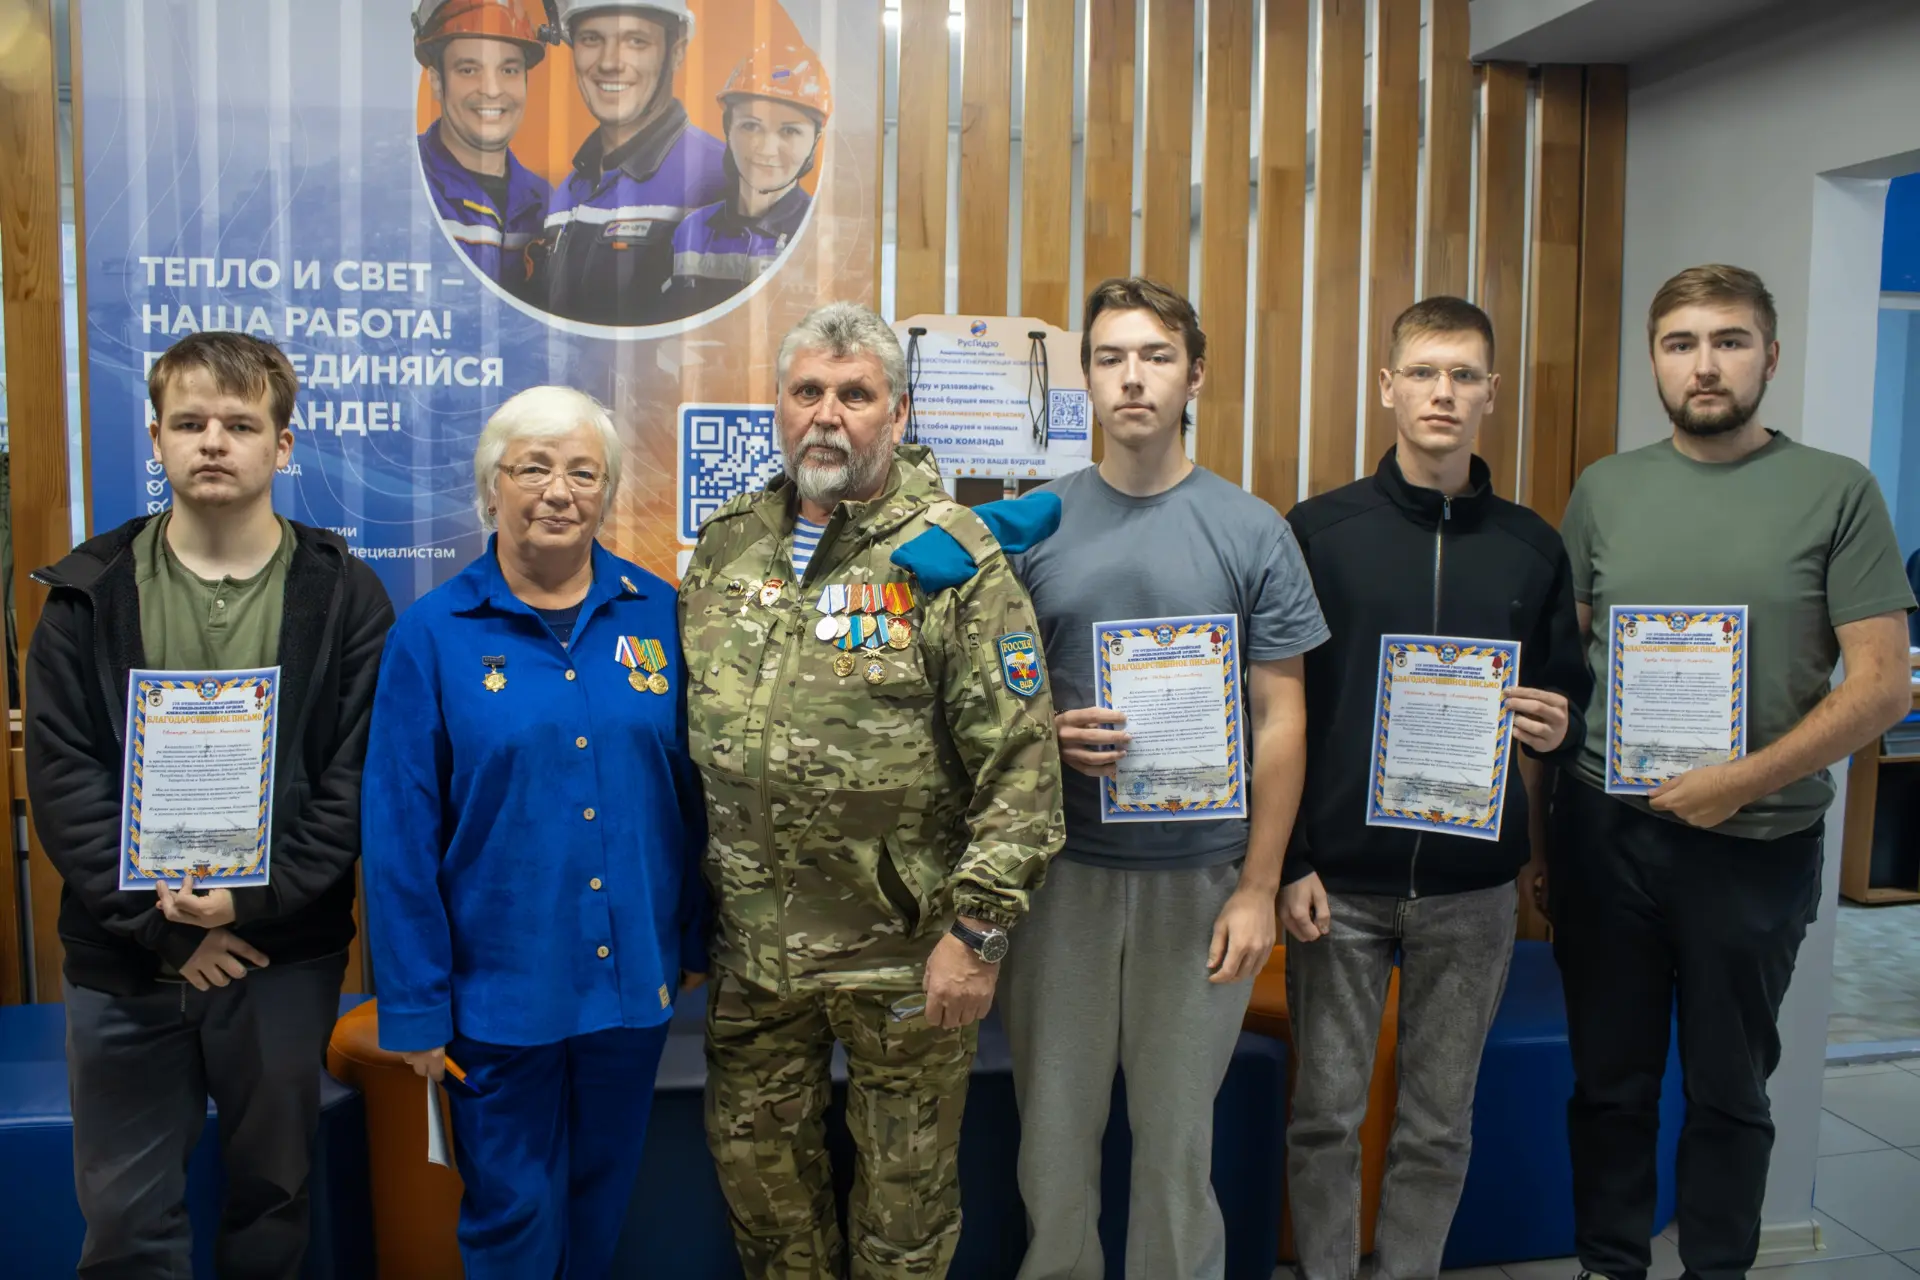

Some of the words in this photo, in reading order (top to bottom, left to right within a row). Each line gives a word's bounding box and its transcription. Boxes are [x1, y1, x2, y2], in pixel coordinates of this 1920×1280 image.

[139, 256, 281, 290] ТЕПЛО
[293, 260, 320, 290] И
[333, 261, 432, 292] СВЕТ
[142, 304, 274, 335] НАША
[285, 307, 451, 340] РАБОТА!
[957, 338, 999, 348] РусГидро
[288, 400, 401, 437] АНДЕ!
[955, 437, 1004, 446] команды
[348, 546, 456, 560] пециалистам
[1002, 638, 1033, 653] РОССИЯ
